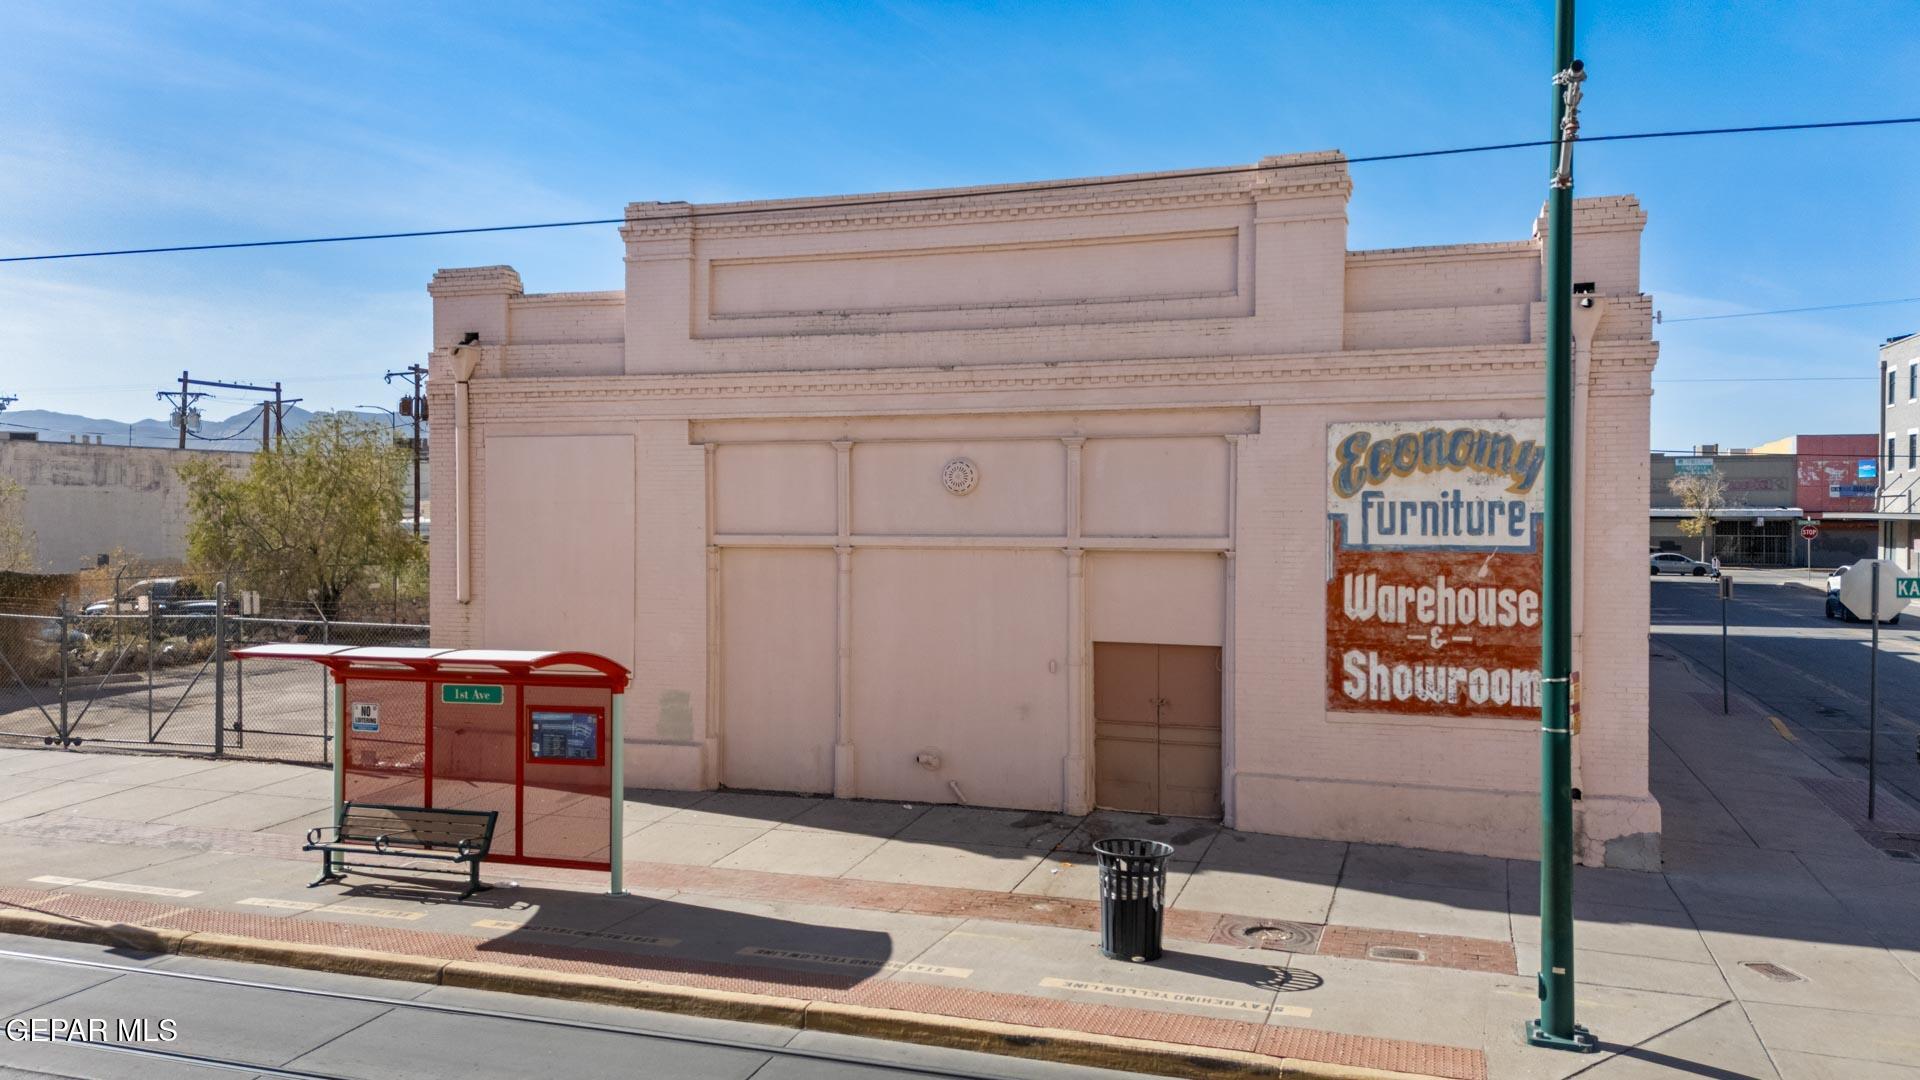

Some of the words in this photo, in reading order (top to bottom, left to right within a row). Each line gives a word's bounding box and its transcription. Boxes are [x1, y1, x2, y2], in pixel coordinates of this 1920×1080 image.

[1333, 427, 1545, 499] Economy
[1362, 489, 1526, 544] Furniture
[1898, 580, 1920, 596] KA
[1343, 573, 1539, 628] Warehouse
[1342, 650, 1543, 708] Showroom
[455, 688, 468, 699] 1st
[473, 689, 490, 700] Ave
[361, 705, 371, 716] NO
[1063, 981, 1099, 991] LINE
[1103, 986, 1169, 999] YELLOW
[1174, 994, 1235, 1007] BEHIND
[1240, 1002, 1285, 1013] STAY
